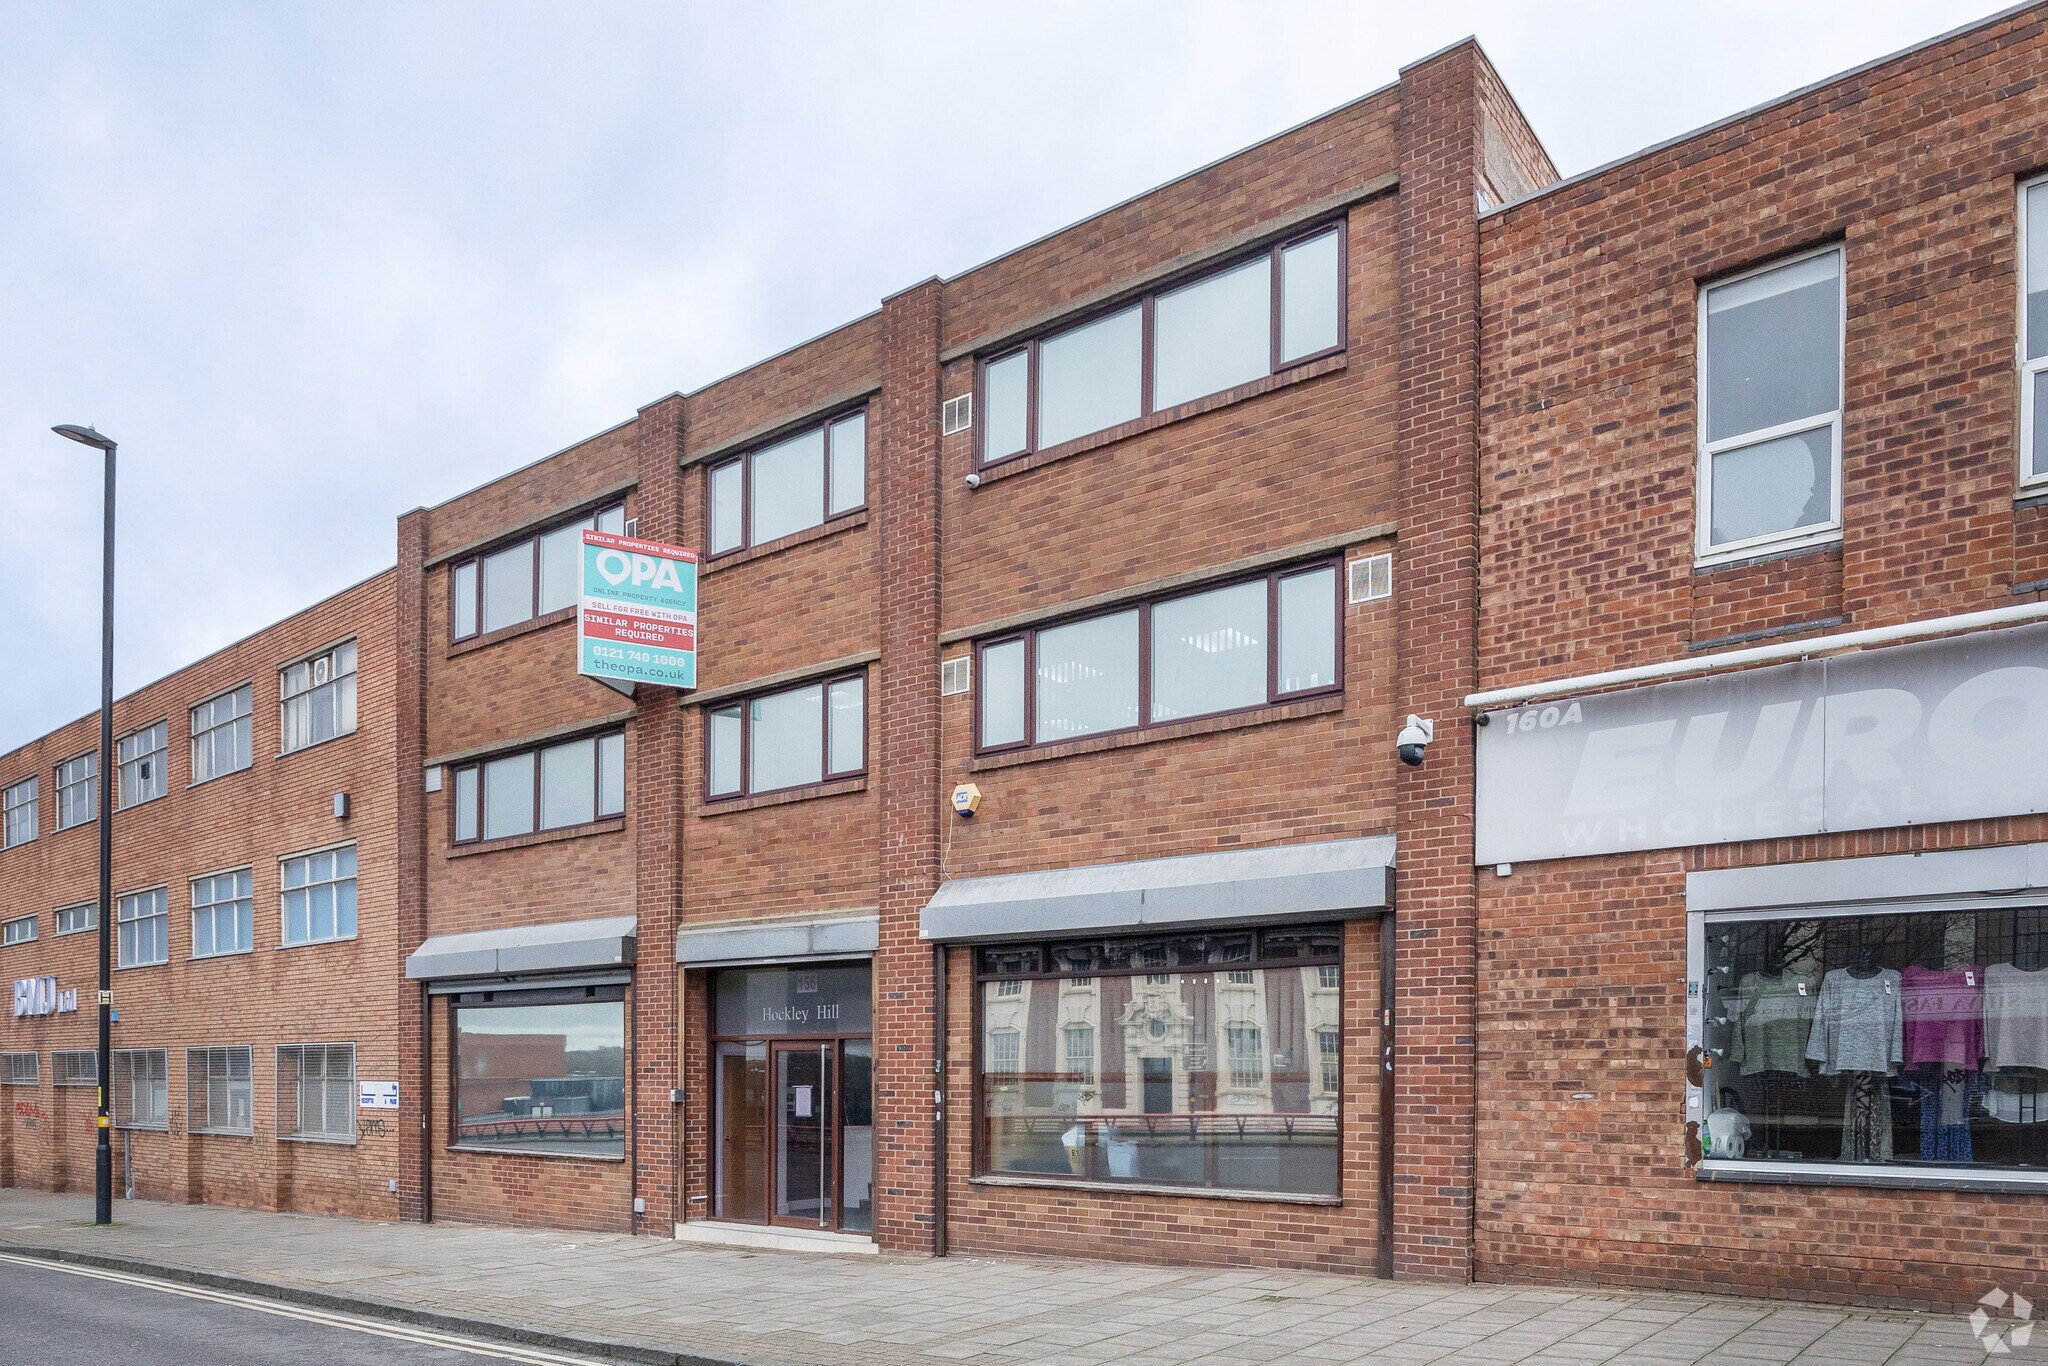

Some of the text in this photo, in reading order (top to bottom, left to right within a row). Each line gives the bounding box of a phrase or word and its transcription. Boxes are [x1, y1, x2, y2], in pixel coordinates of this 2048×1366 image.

[585, 533, 695, 558] SIMILAR PROPERTIES REQUIRED
[596, 549, 683, 593] OPA
[592, 586, 686, 606] ONLINE PROPERTY AGENCY
[592, 601, 611, 610] SELL
[613, 605, 629, 613] FOR
[630, 607, 649, 616] FREE
[651, 610, 671, 619] WITH
[584, 613, 694, 637] SIMILAR PROPERTIES
[615, 627, 665, 642] REQUIRED
[593, 645, 685, 667] 0121 740 1000
[594, 658, 685, 680] theopa.co.uk
[1505, 702, 1583, 735] 160A
[763, 1004, 840, 1024] Hockley Hill
